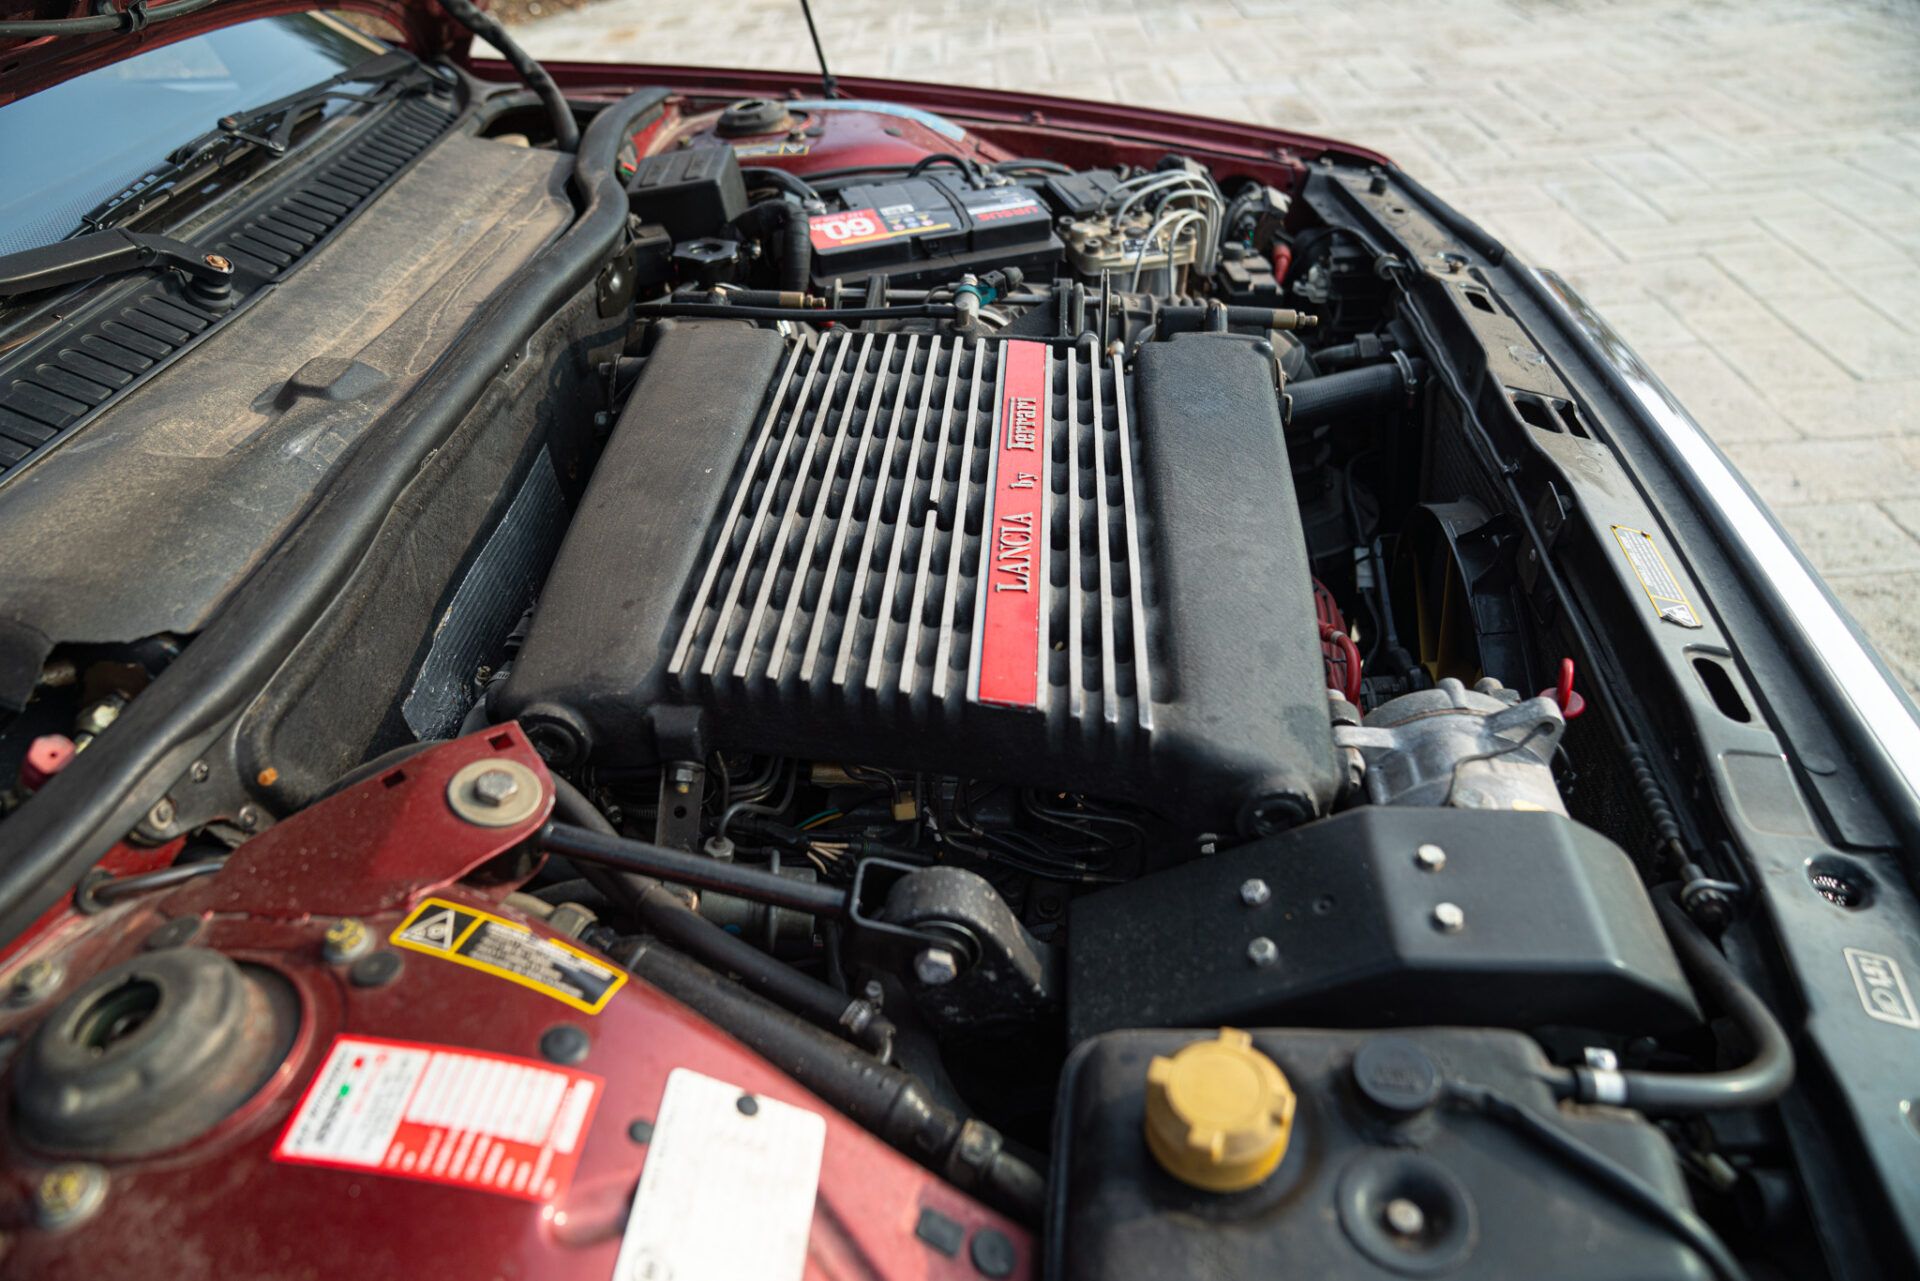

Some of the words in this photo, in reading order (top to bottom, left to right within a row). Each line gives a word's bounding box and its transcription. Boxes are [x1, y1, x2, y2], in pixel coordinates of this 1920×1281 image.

[1007, 397, 1037, 451] Ferrari
[1009, 472, 1039, 489] by
[996, 512, 1033, 593] LANCIA
